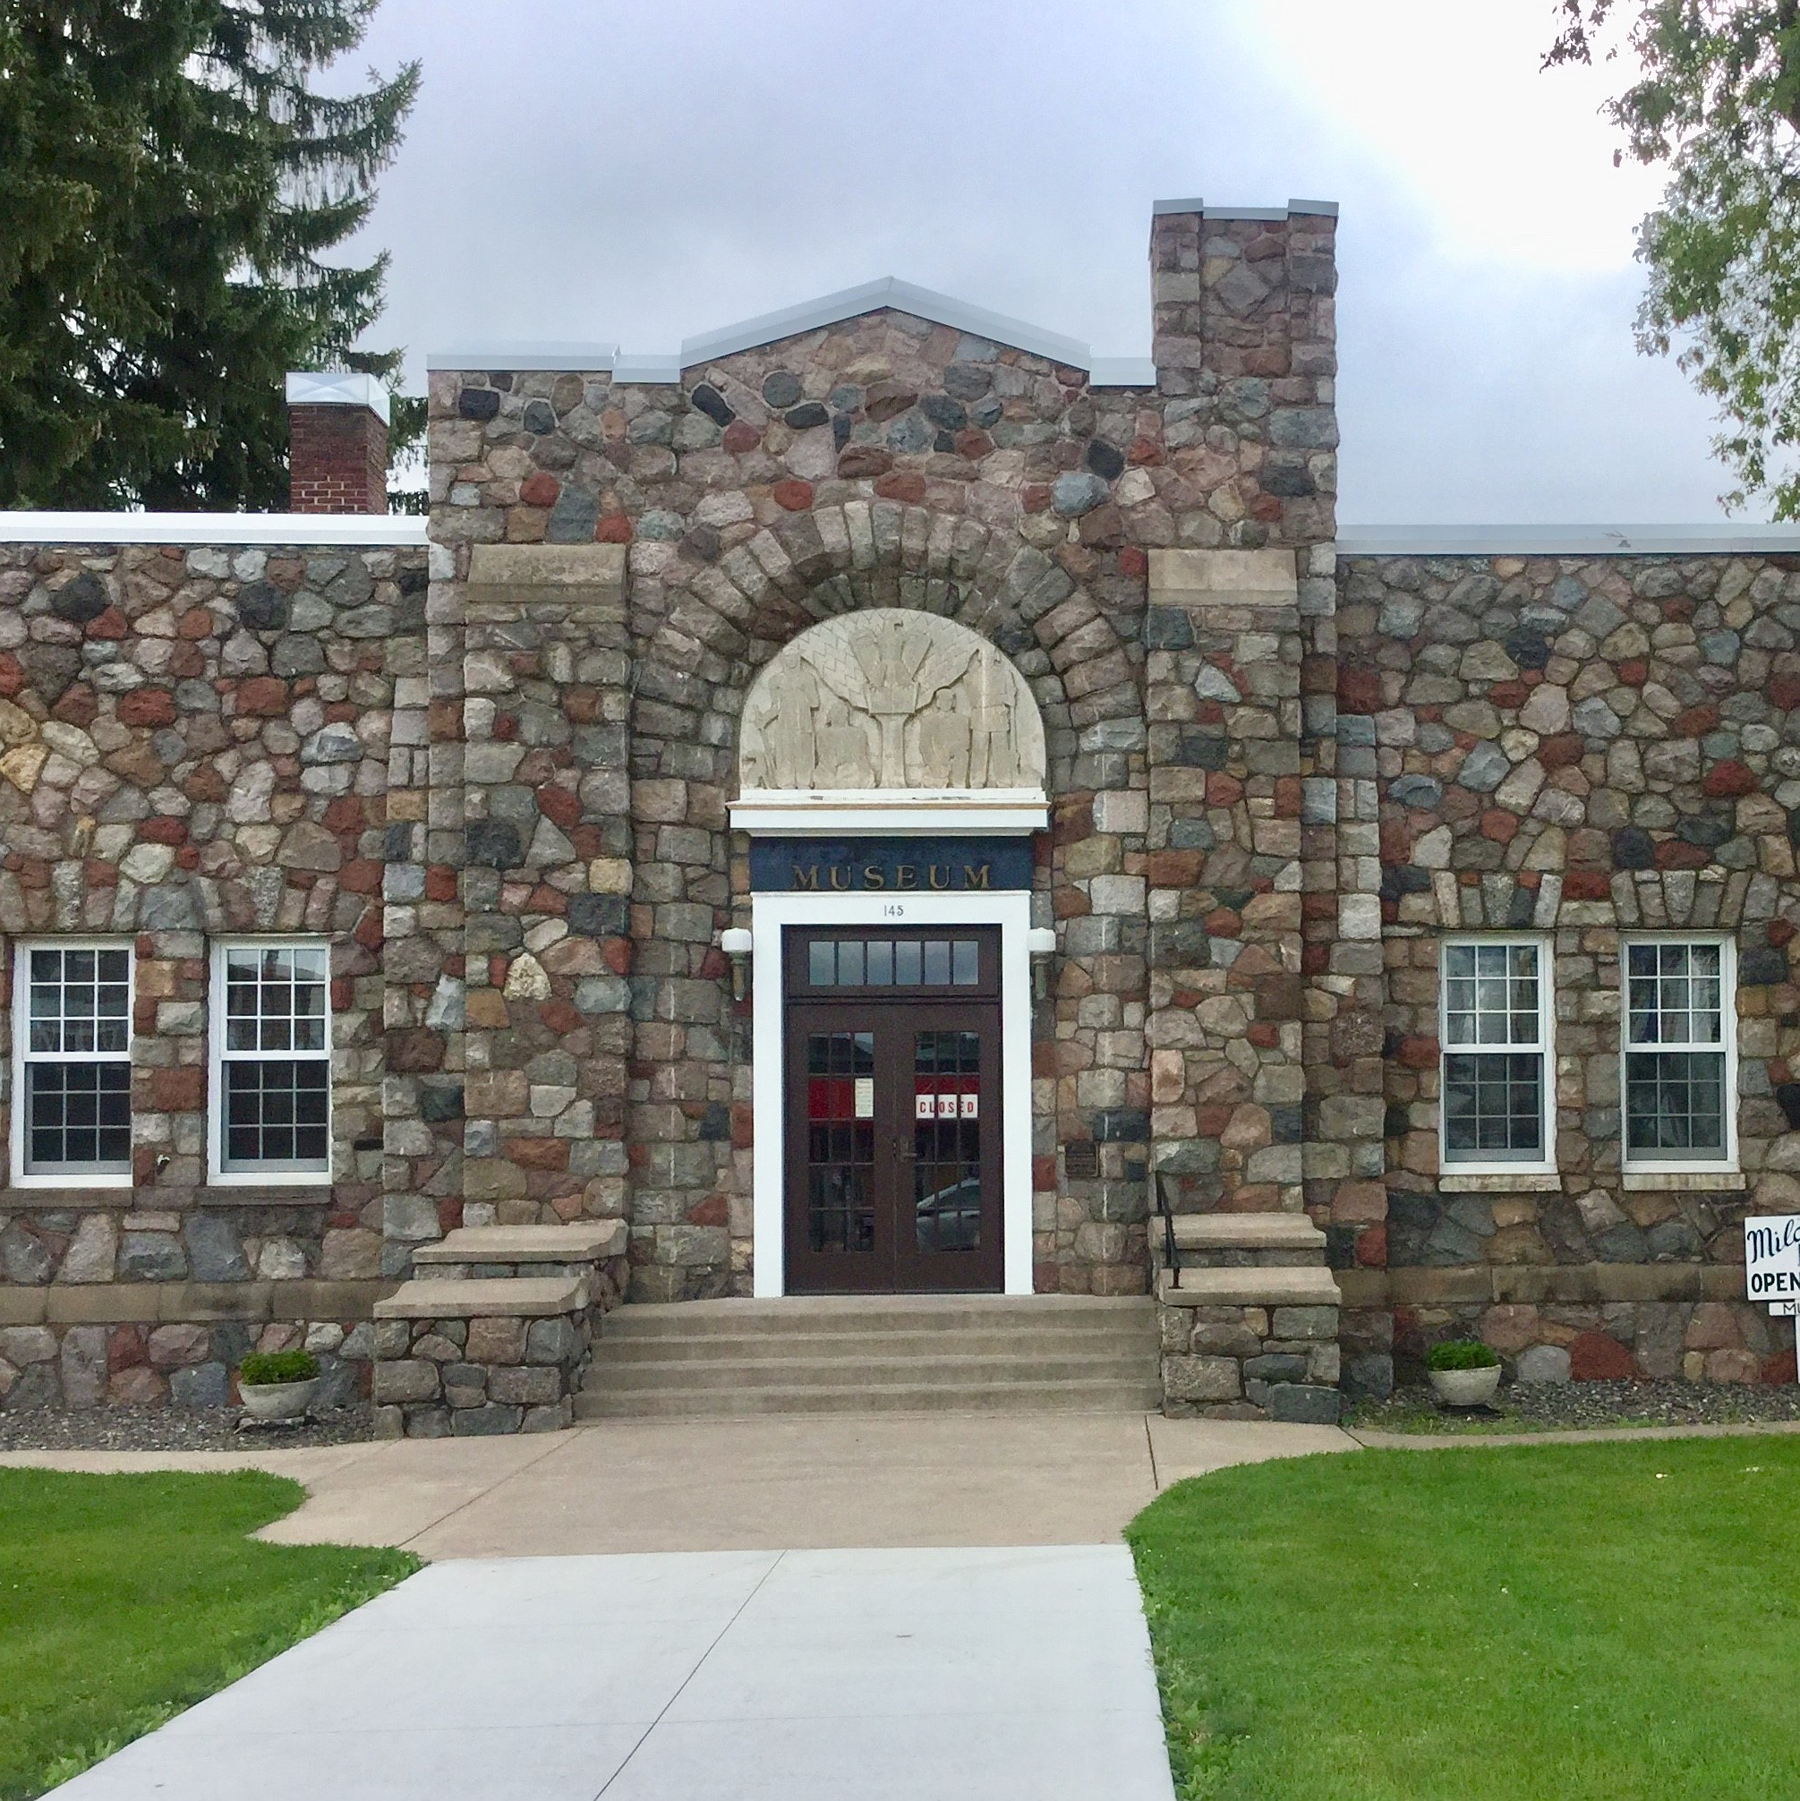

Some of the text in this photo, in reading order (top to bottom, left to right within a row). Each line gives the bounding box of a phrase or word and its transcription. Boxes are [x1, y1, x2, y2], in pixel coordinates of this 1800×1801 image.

[792, 865, 991, 889] MUSEUM
[884, 904, 904, 917] 145
[919, 1101, 975, 1113] CLOSED
[1752, 1272, 1800, 1293] OPEN
